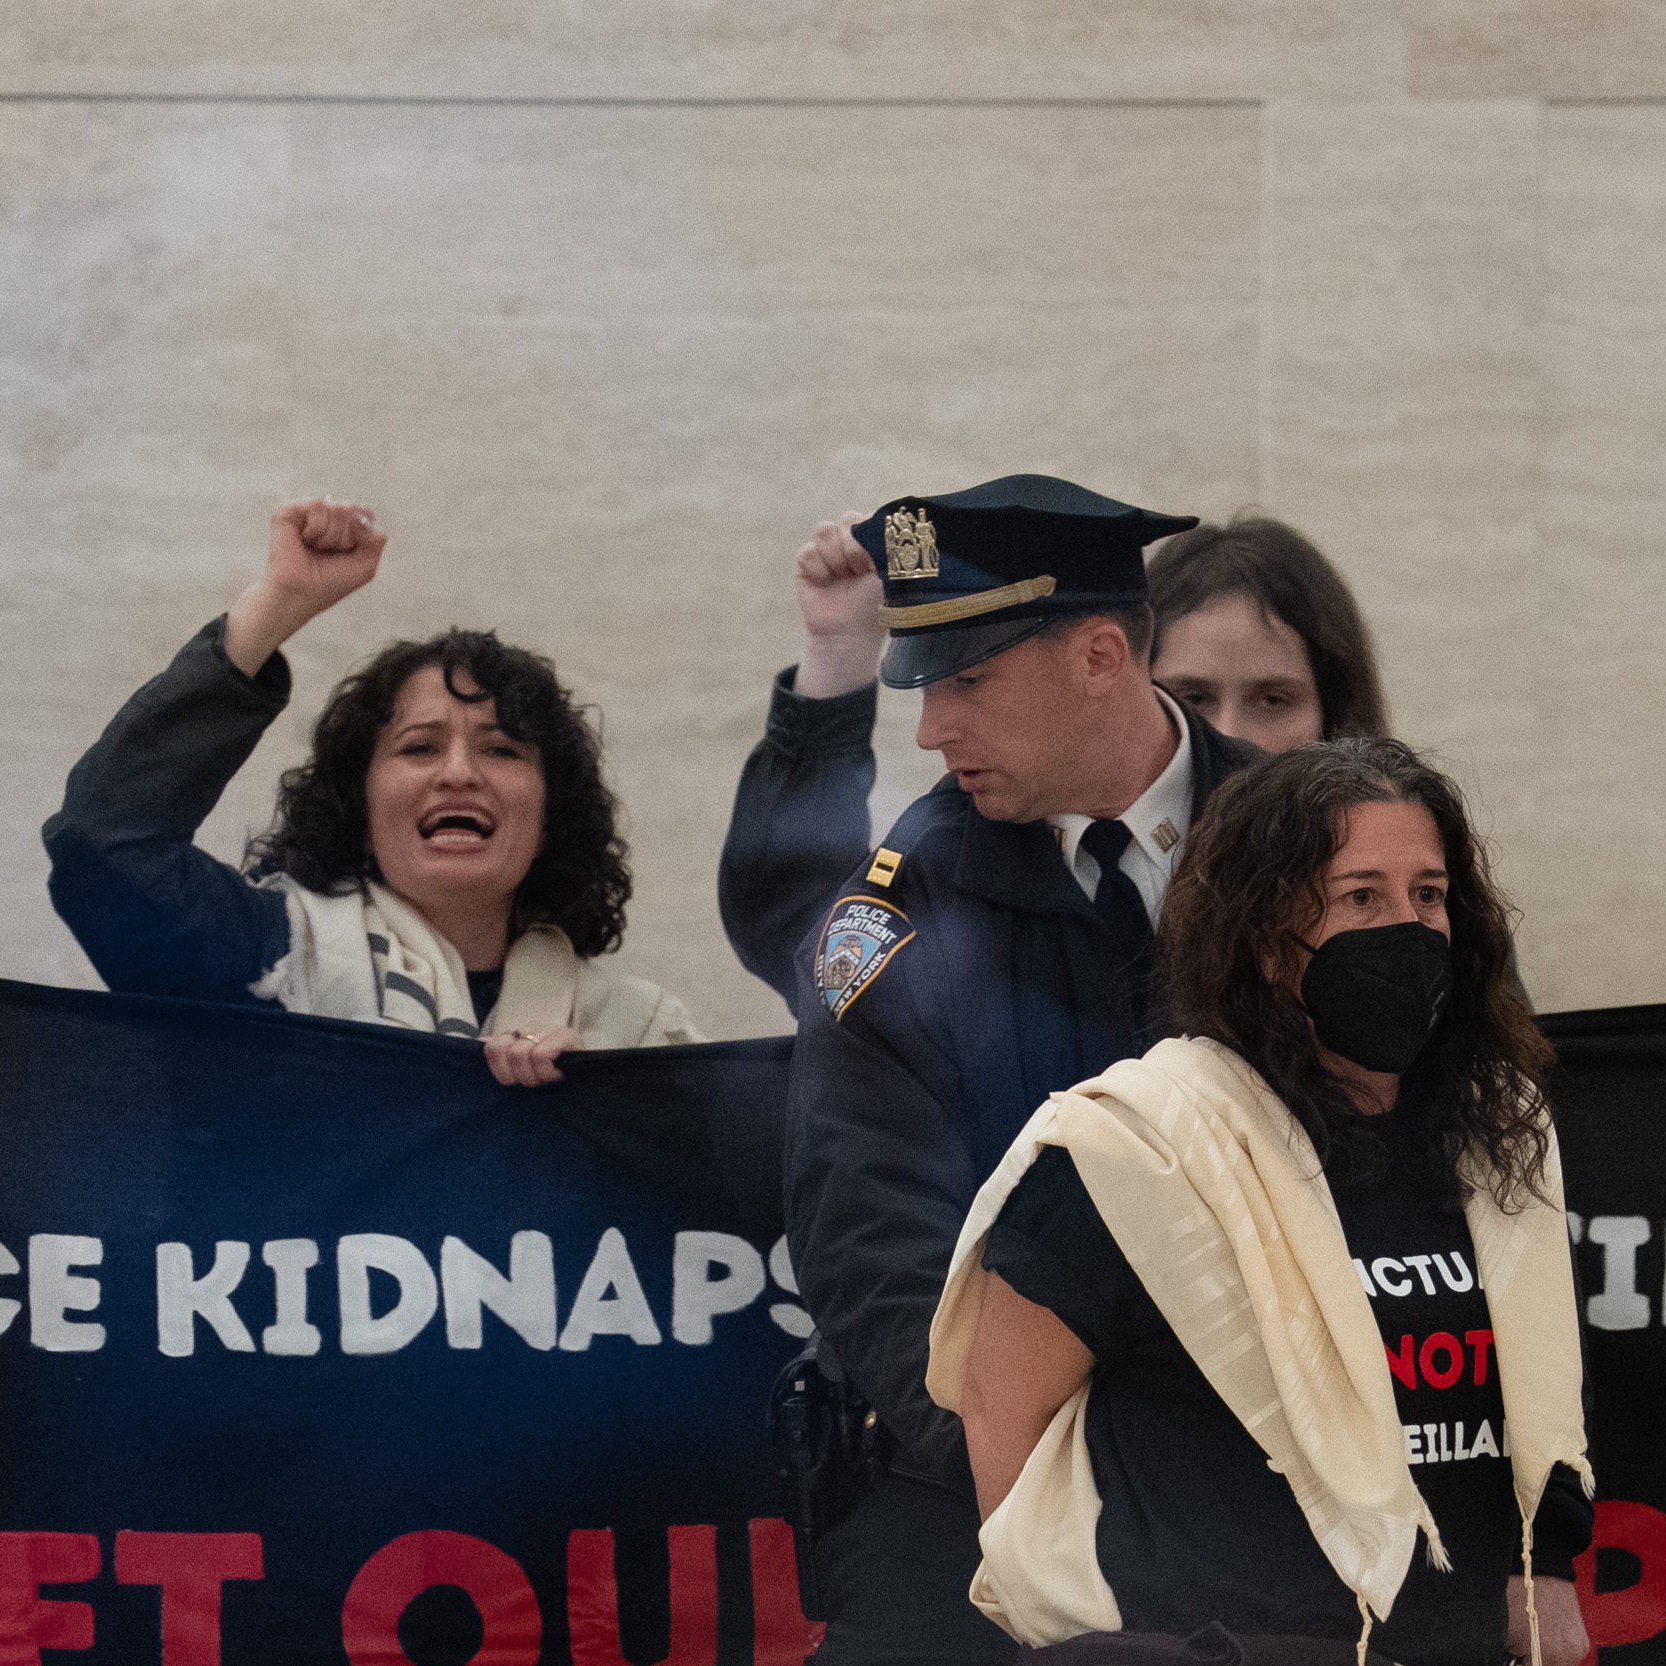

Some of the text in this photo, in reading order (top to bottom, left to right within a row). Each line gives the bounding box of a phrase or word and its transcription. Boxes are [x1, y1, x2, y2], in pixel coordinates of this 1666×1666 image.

[845, 904, 892, 925] POLICE
[827, 917, 897, 944] DEPARTMENT
[853, 951, 886, 987] YORK
[1383, 1329, 1495, 1390] NOT
